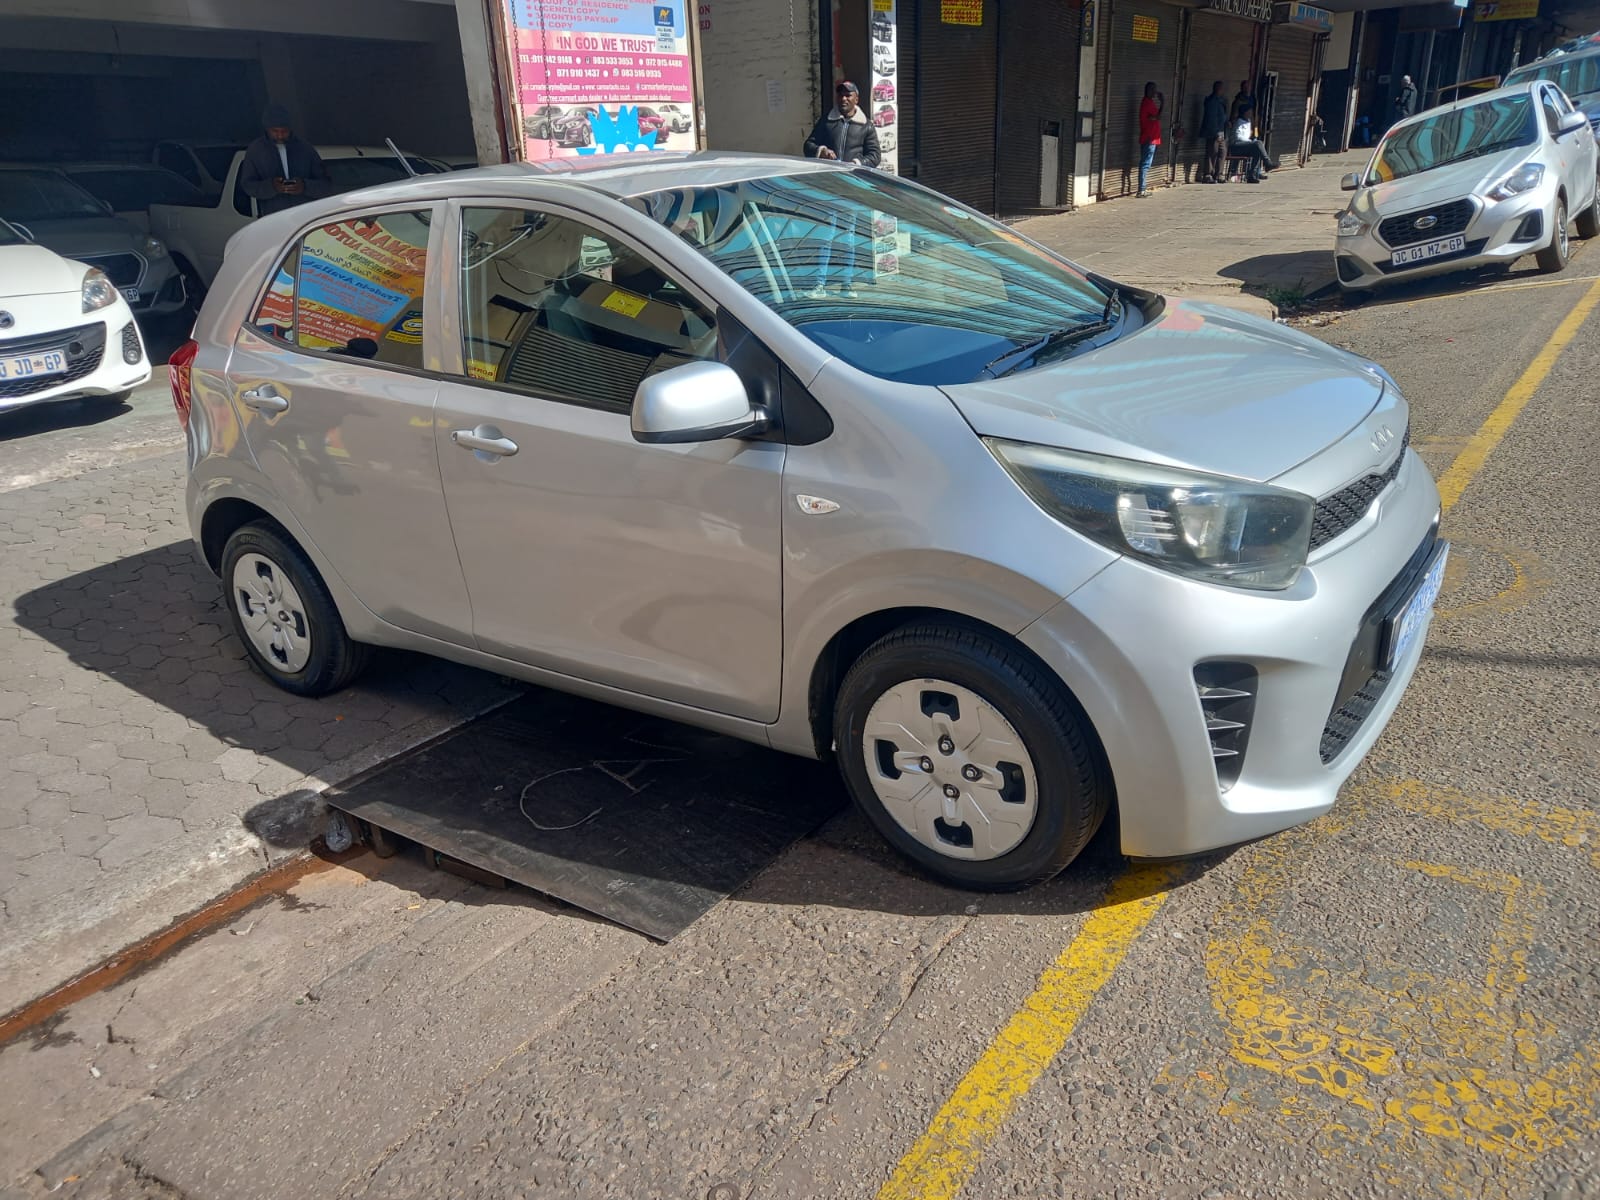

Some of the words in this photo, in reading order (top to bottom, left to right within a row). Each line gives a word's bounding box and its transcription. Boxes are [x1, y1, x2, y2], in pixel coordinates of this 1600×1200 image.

[544, 13, 581, 21] MONTHS
[585, 16, 618, 24] PAYSLIP
[575, 37, 598, 50] GOD
[601, 38, 617, 51] WE
[1395, 251, 1407, 264] JC
[1411, 247, 1424, 260] 01
[1427, 243, 1441, 257] MZ
[1448, 238, 1462, 251] GP
[126, 289, 138, 301] GP
[15, 358, 34, 376] JD
[44, 353, 61, 370] GP
